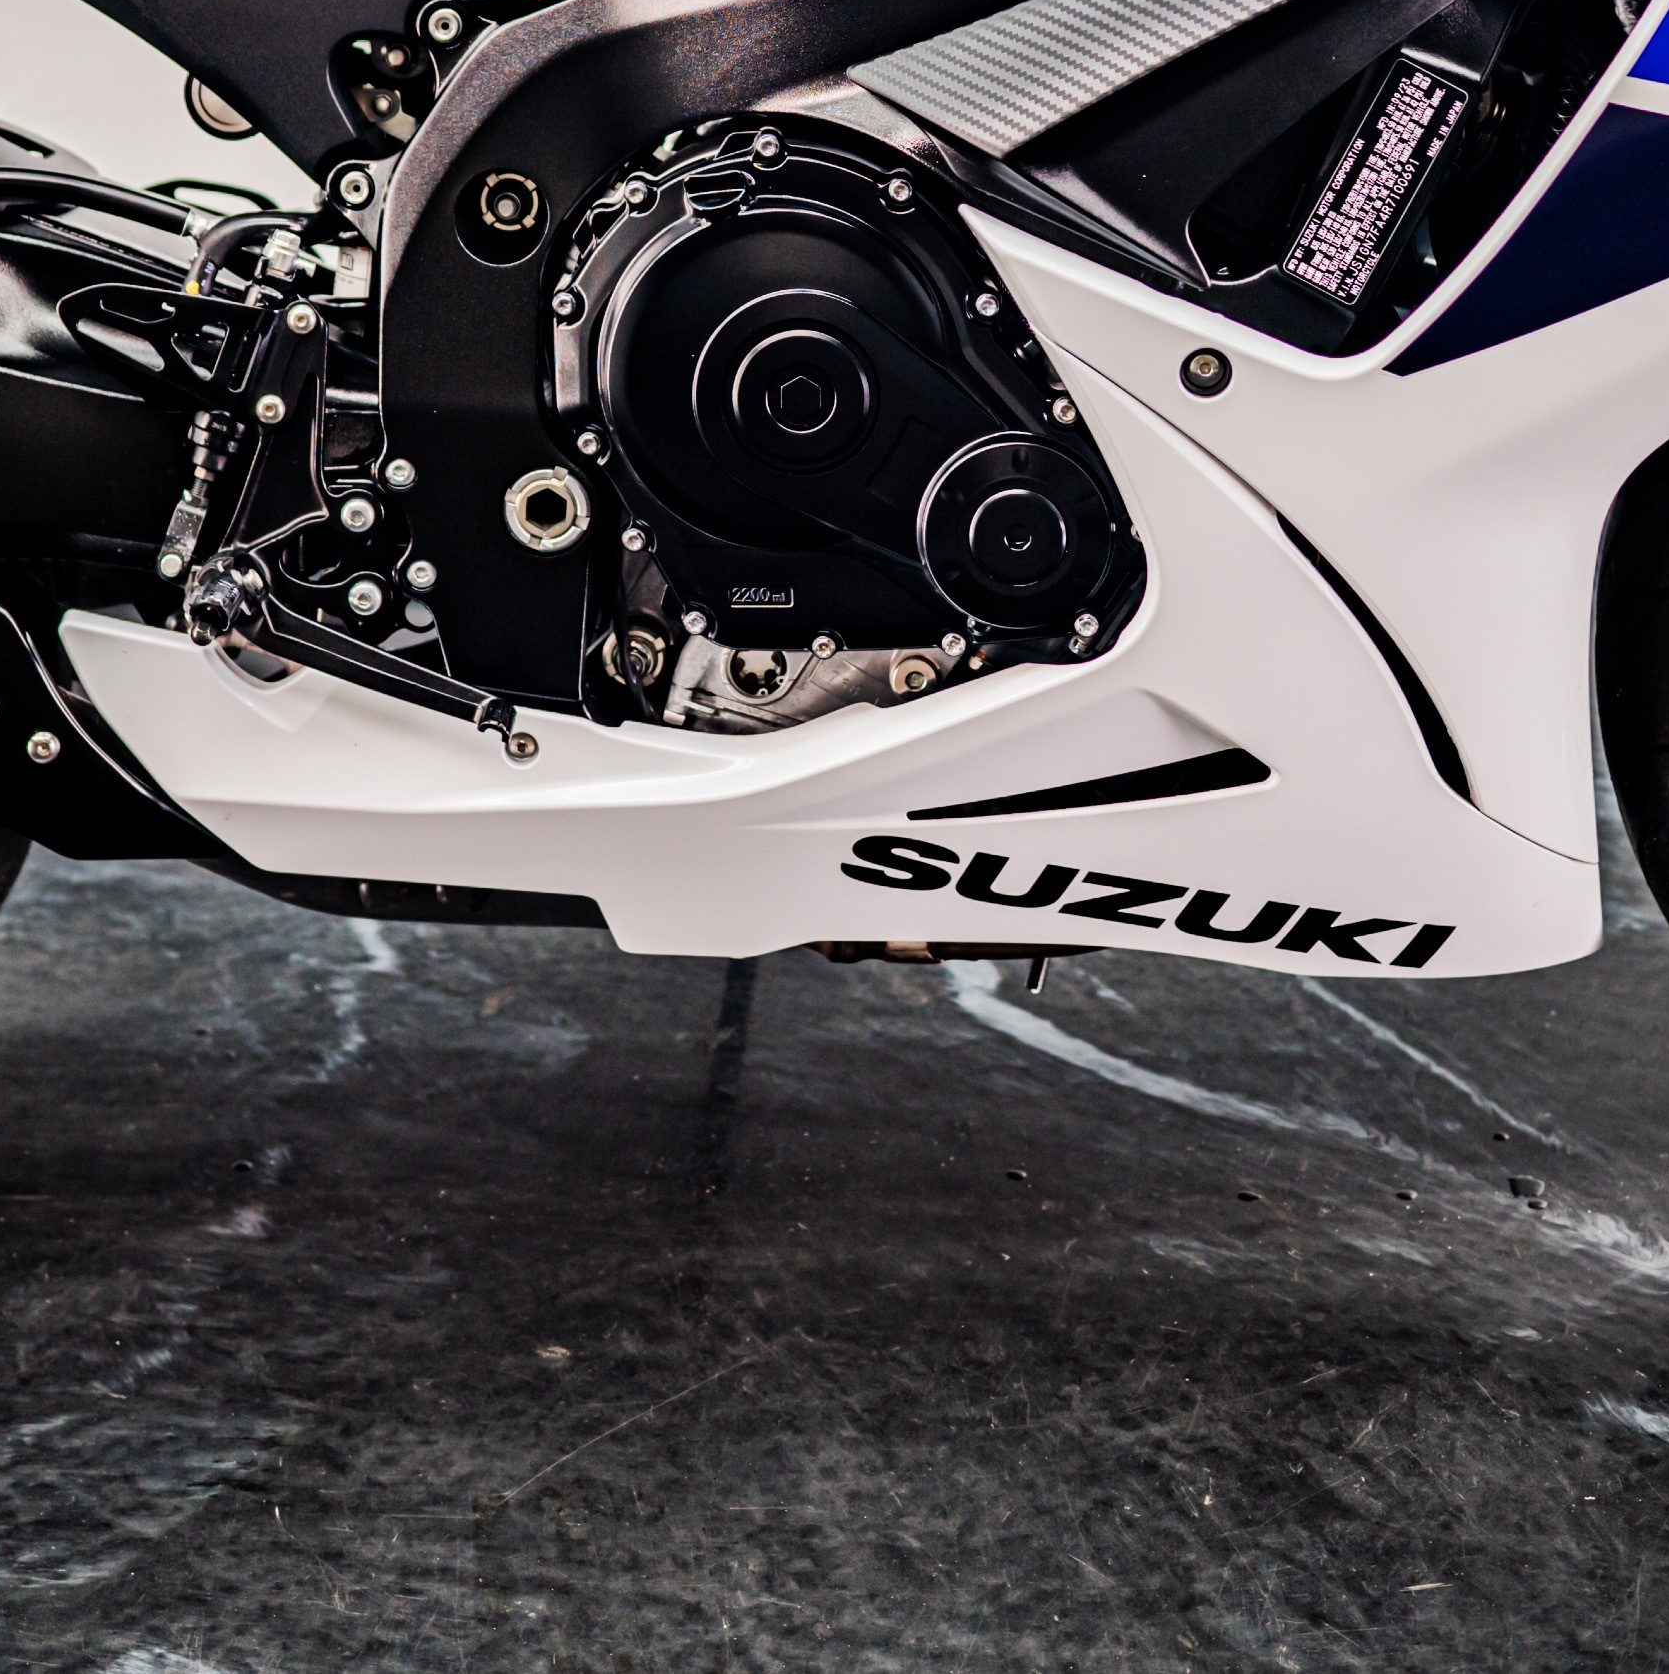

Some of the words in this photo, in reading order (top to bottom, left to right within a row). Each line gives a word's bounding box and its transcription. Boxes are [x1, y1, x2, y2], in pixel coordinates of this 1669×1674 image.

[1410, 96, 1430, 122] VEHICLE
[1400, 120, 1417, 141] MOTOR
[1426, 136, 1443, 158] MADE
[1438, 124, 1450, 136] IN
[1444, 99, 1463, 125] JAPAN
[1386, 139, 1406, 165] FEDERAL
[1398, 124, 1424, 163] MANUFACTURE
[1392, 162, 1404, 172] OF
[1368, 164, 1392, 199] APPLICABLE
[1384, 171, 1399, 188] DATE
[1300, 218, 1321, 247] SUZUKI
[1316, 190, 1336, 216] MOTOR
[1331, 137, 1365, 190] CORPORATION
[1372, 198, 1383, 209] ON
[1377, 186, 1390, 199] THE
[1347, 157, 1420, 277] JS1GN7FA4R7100691
[1356, 210, 1367, 220] TO
[1361, 199, 1373, 211] ALL
[1360, 208, 1378, 231] EFFECT
[1355, 229, 1366, 239] IN
[1327, 247, 1346, 273] VEHICLE
[1338, 238, 1361, 271] STANDARDS
[1319, 271, 1333, 288] THIS
[1326, 269, 1344, 292] SAFETY
[1349, 250, 1379, 296] MOTORCYCLE
[840, 834, 1457, 969] SUZUKI
